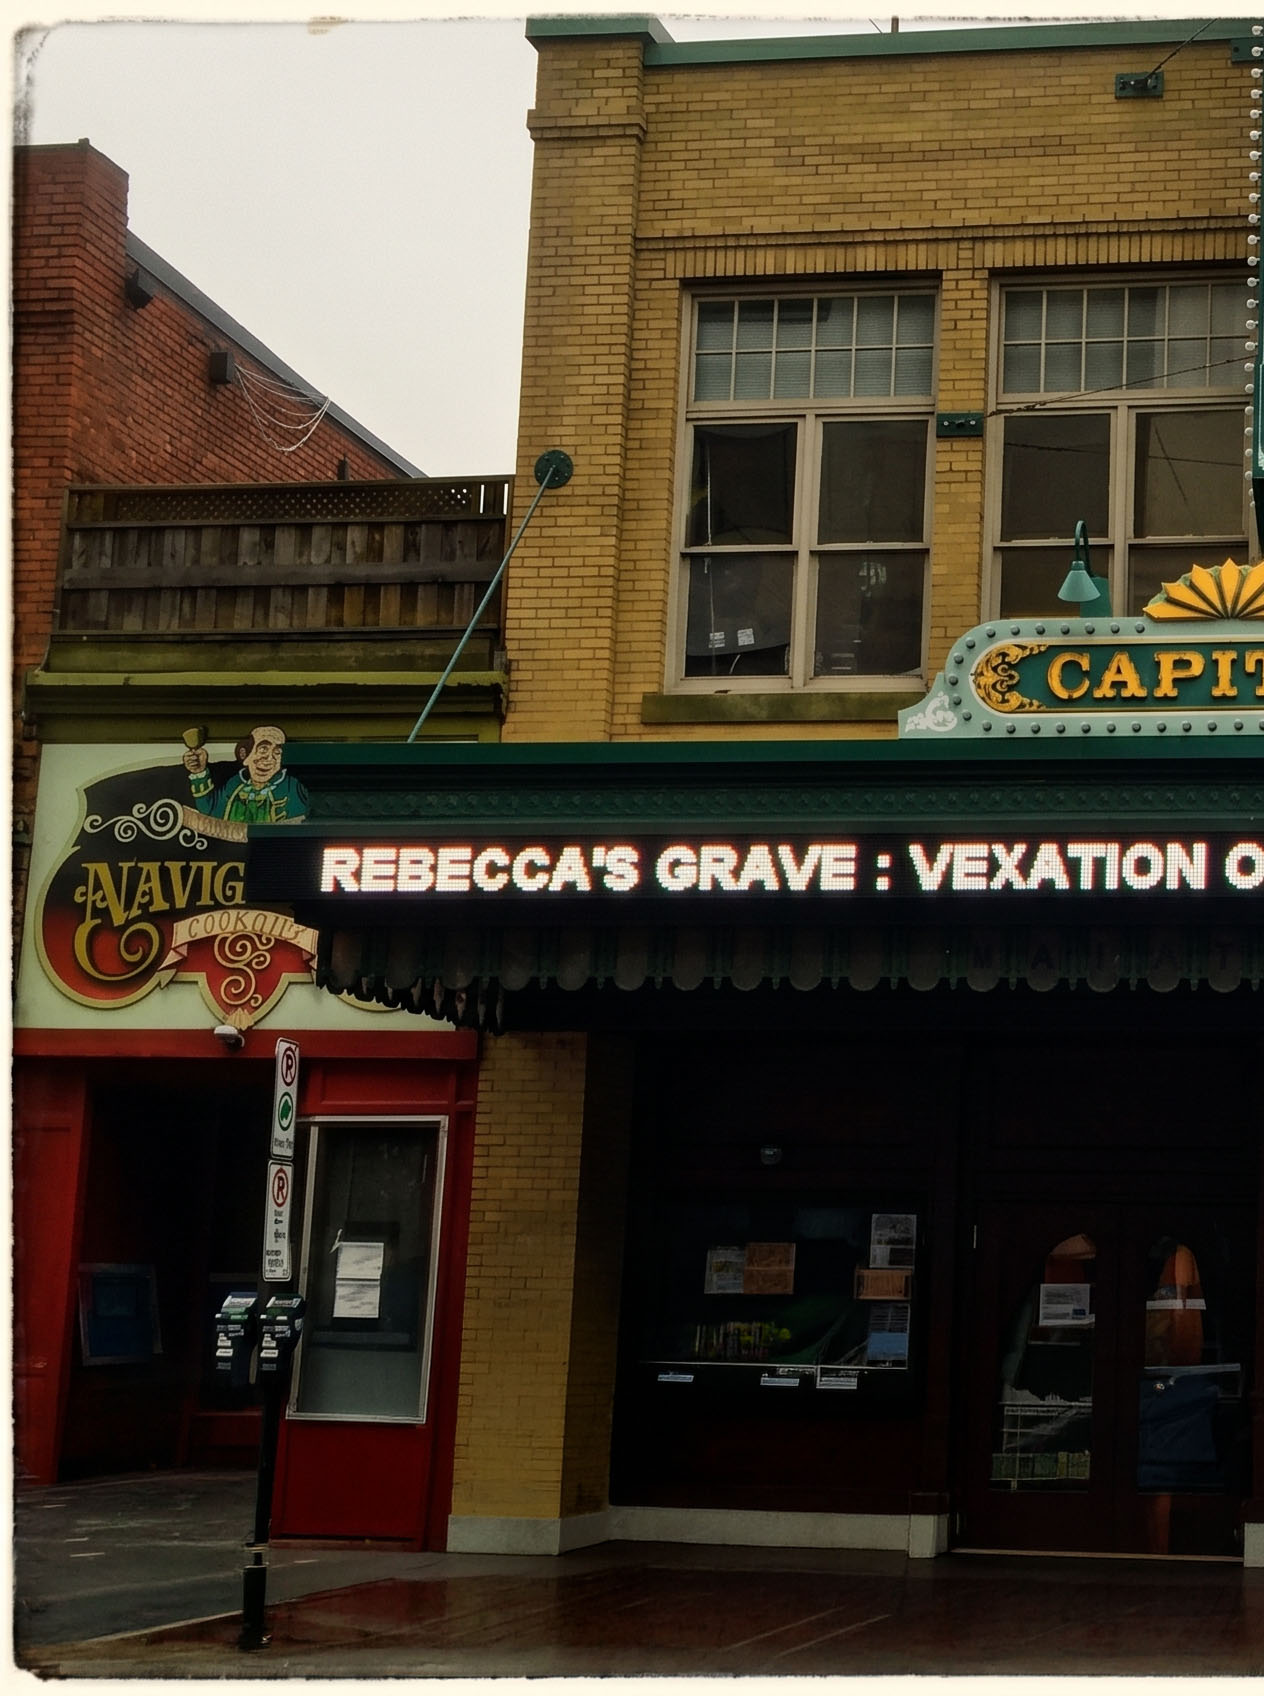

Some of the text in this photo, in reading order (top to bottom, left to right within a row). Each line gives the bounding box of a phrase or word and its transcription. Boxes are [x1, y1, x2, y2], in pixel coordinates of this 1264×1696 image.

[74, 857, 247, 932] NAVIG
[320, 844, 641, 892] REBECCA'S
[655, 843, 858, 891] GRAVE
[908, 841, 1208, 891] VEXATION
